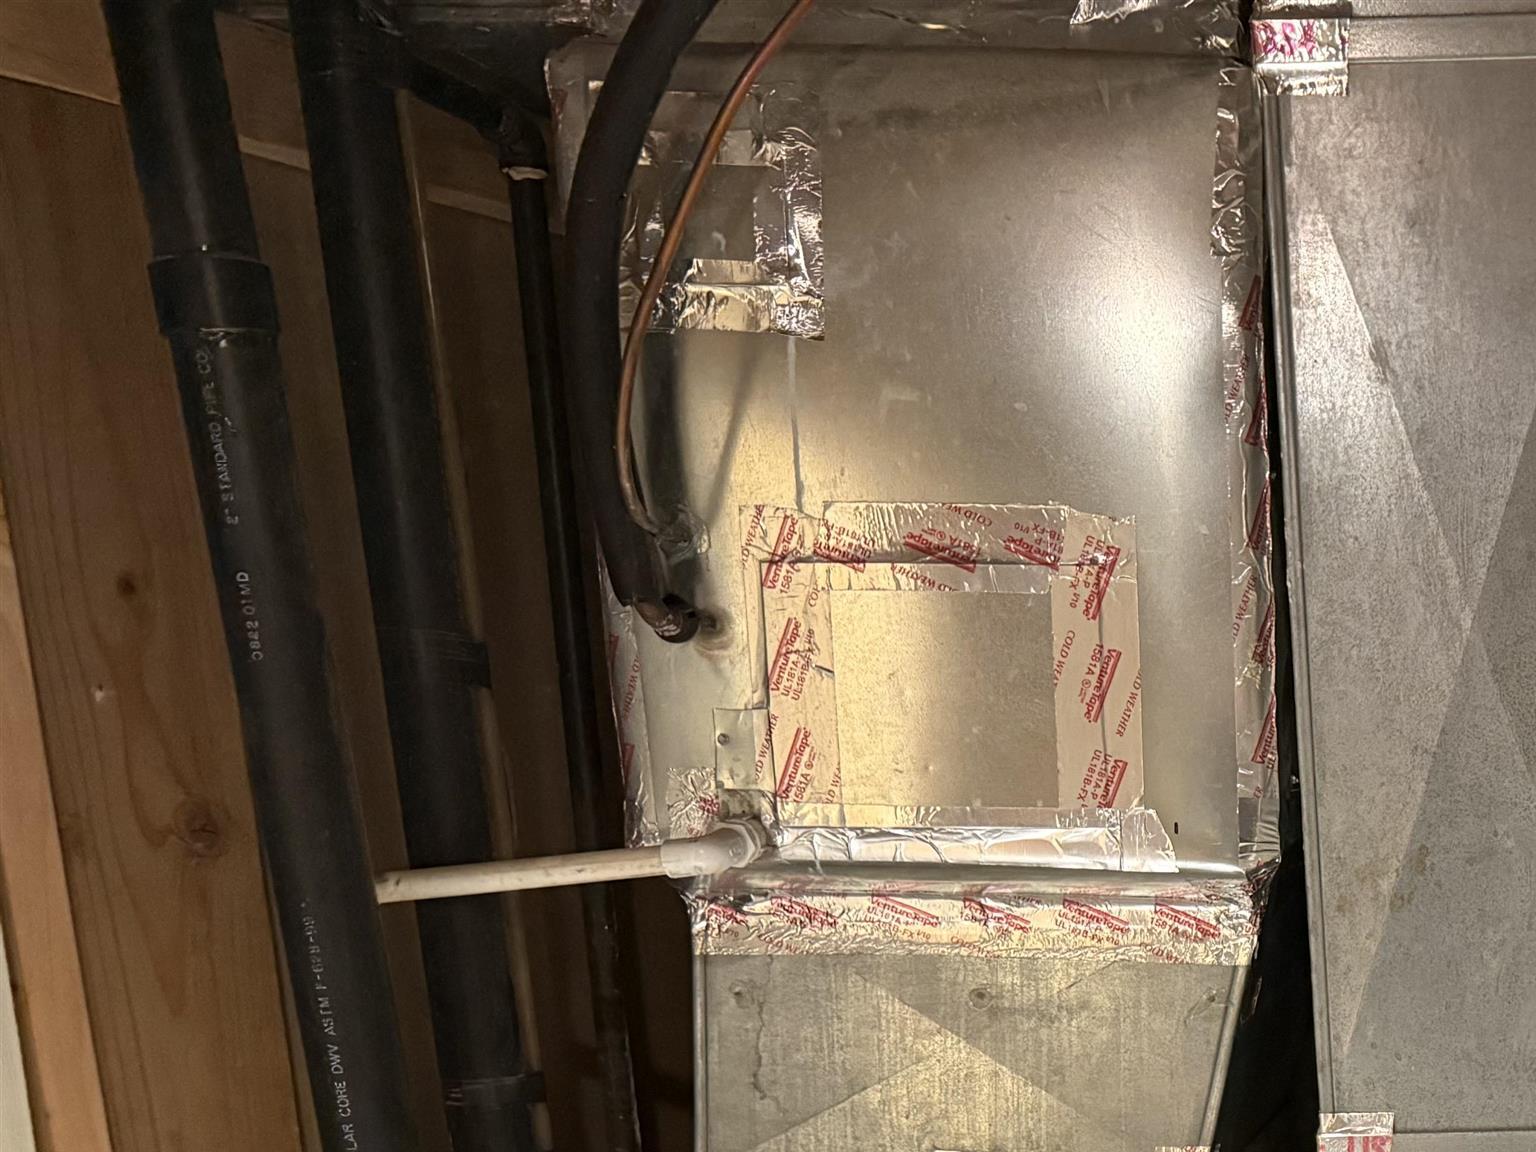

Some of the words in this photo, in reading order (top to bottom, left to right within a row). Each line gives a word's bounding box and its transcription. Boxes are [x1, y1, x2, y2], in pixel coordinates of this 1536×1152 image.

[210, 422, 233, 502] STANDARD
[771, 617, 801, 692] VentureTape
[1060, 630, 1076, 659] COLD
[1085, 643, 1104, 676] 1581A
[1084, 648, 1117, 723] VentureTape
[1116, 691, 1139, 737] WEATHER
[780, 727, 811, 800] VentureTape
[1077, 749, 1102, 802] UL181B-FX
[1064, 902, 1131, 934] VentureTape
[1155, 907, 1221, 939] VentureTape
[318, 997, 338, 1037] ASTM
[327, 1044, 344, 1075] DWV
[336, 1080, 352, 1118] CORE
